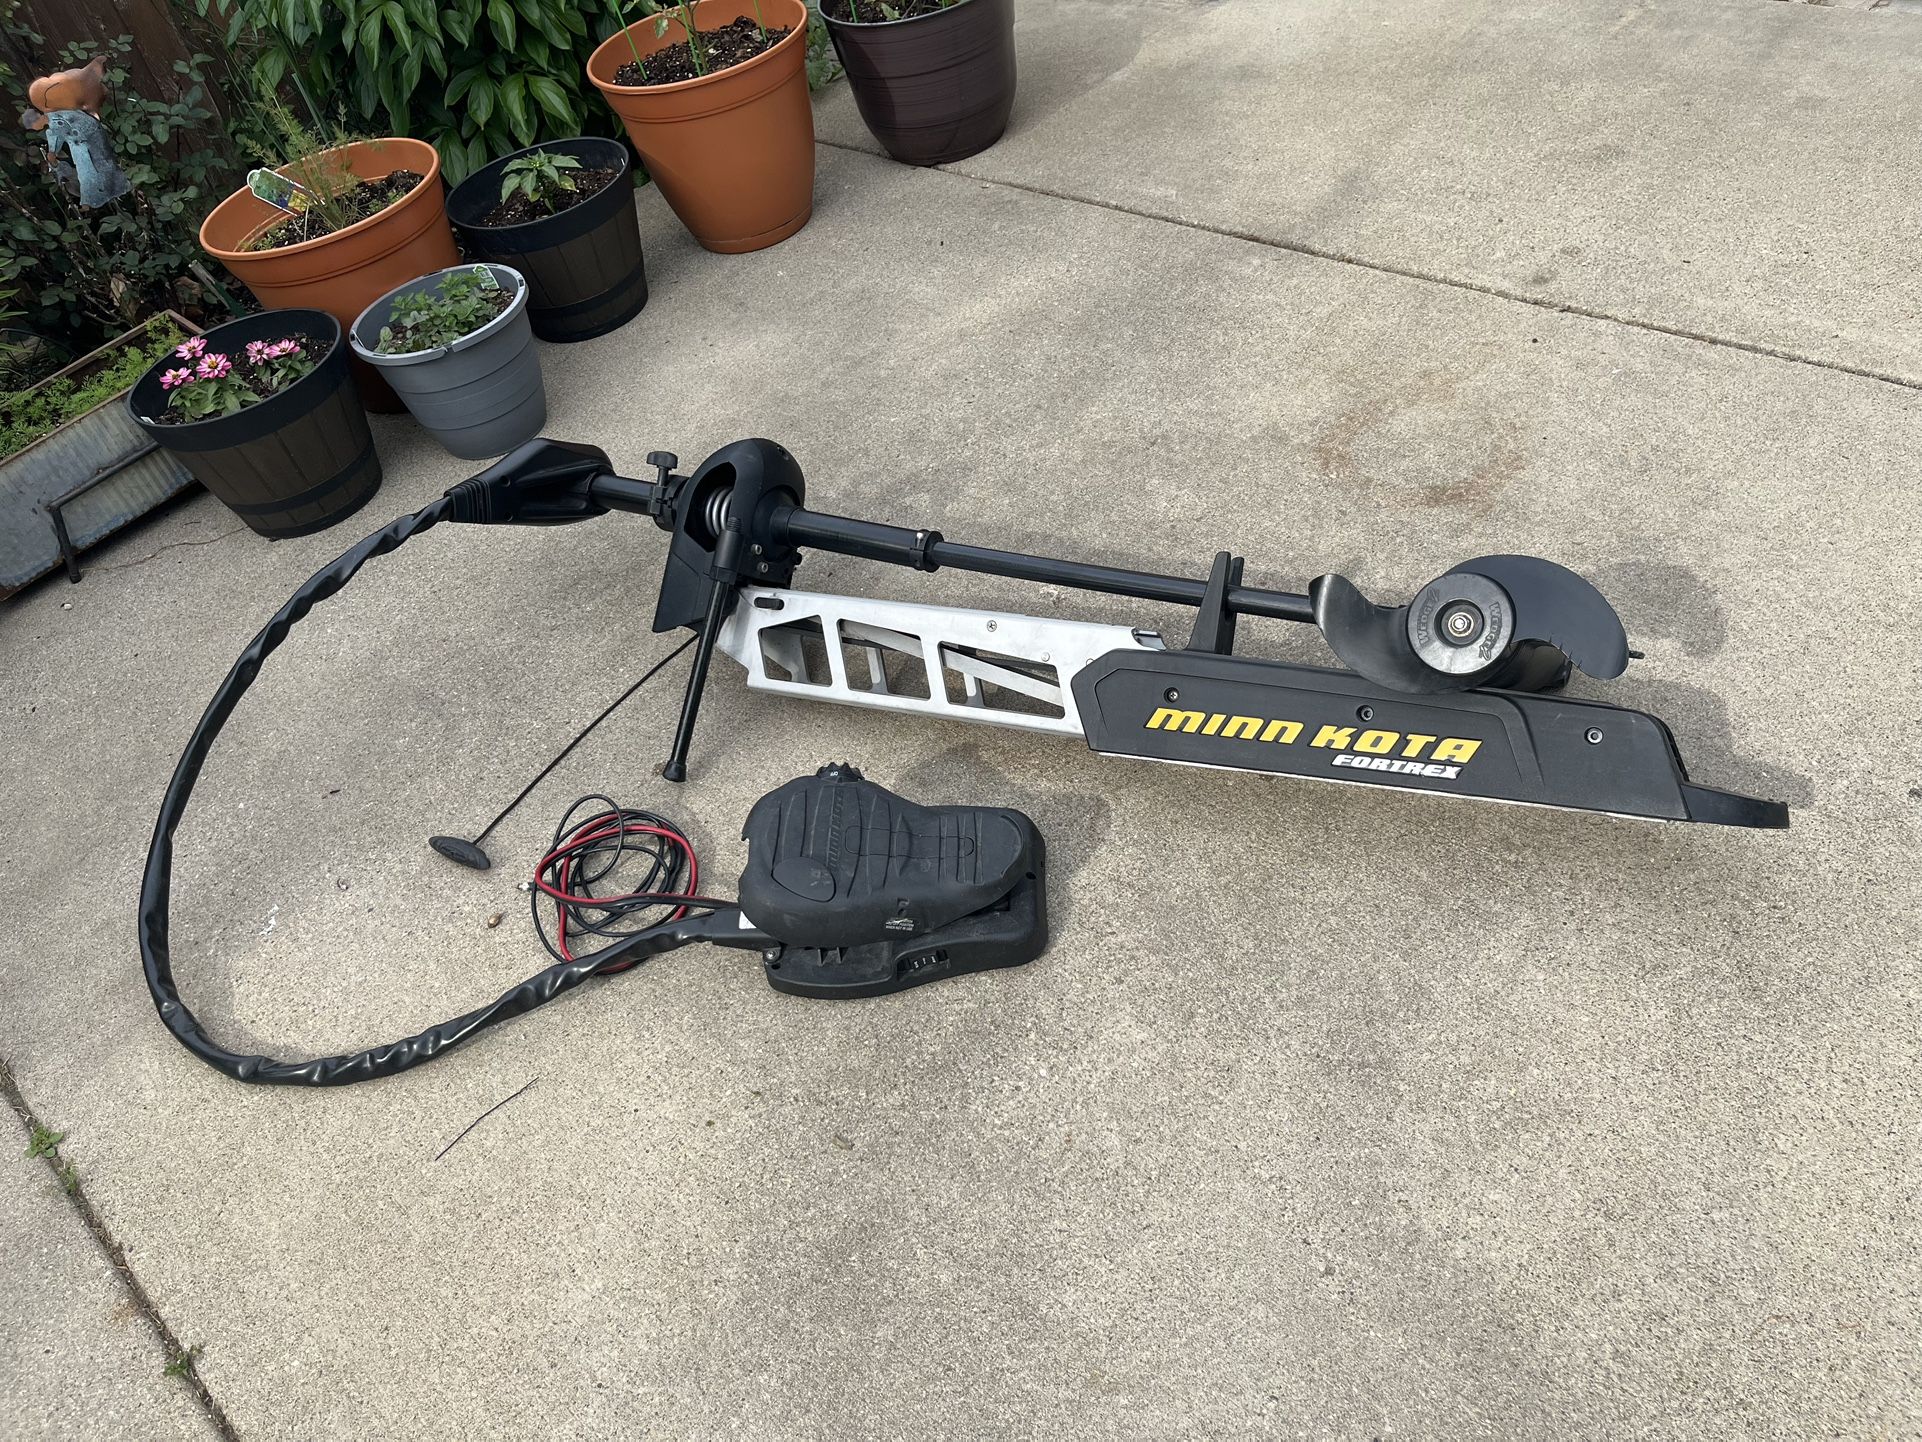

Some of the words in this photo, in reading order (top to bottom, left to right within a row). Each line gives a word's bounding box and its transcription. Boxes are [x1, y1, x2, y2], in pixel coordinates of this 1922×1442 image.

[1146, 707, 1304, 744] MINN
[1310, 725, 1482, 763] KOTA
[1333, 755, 1462, 779] FORTREX
